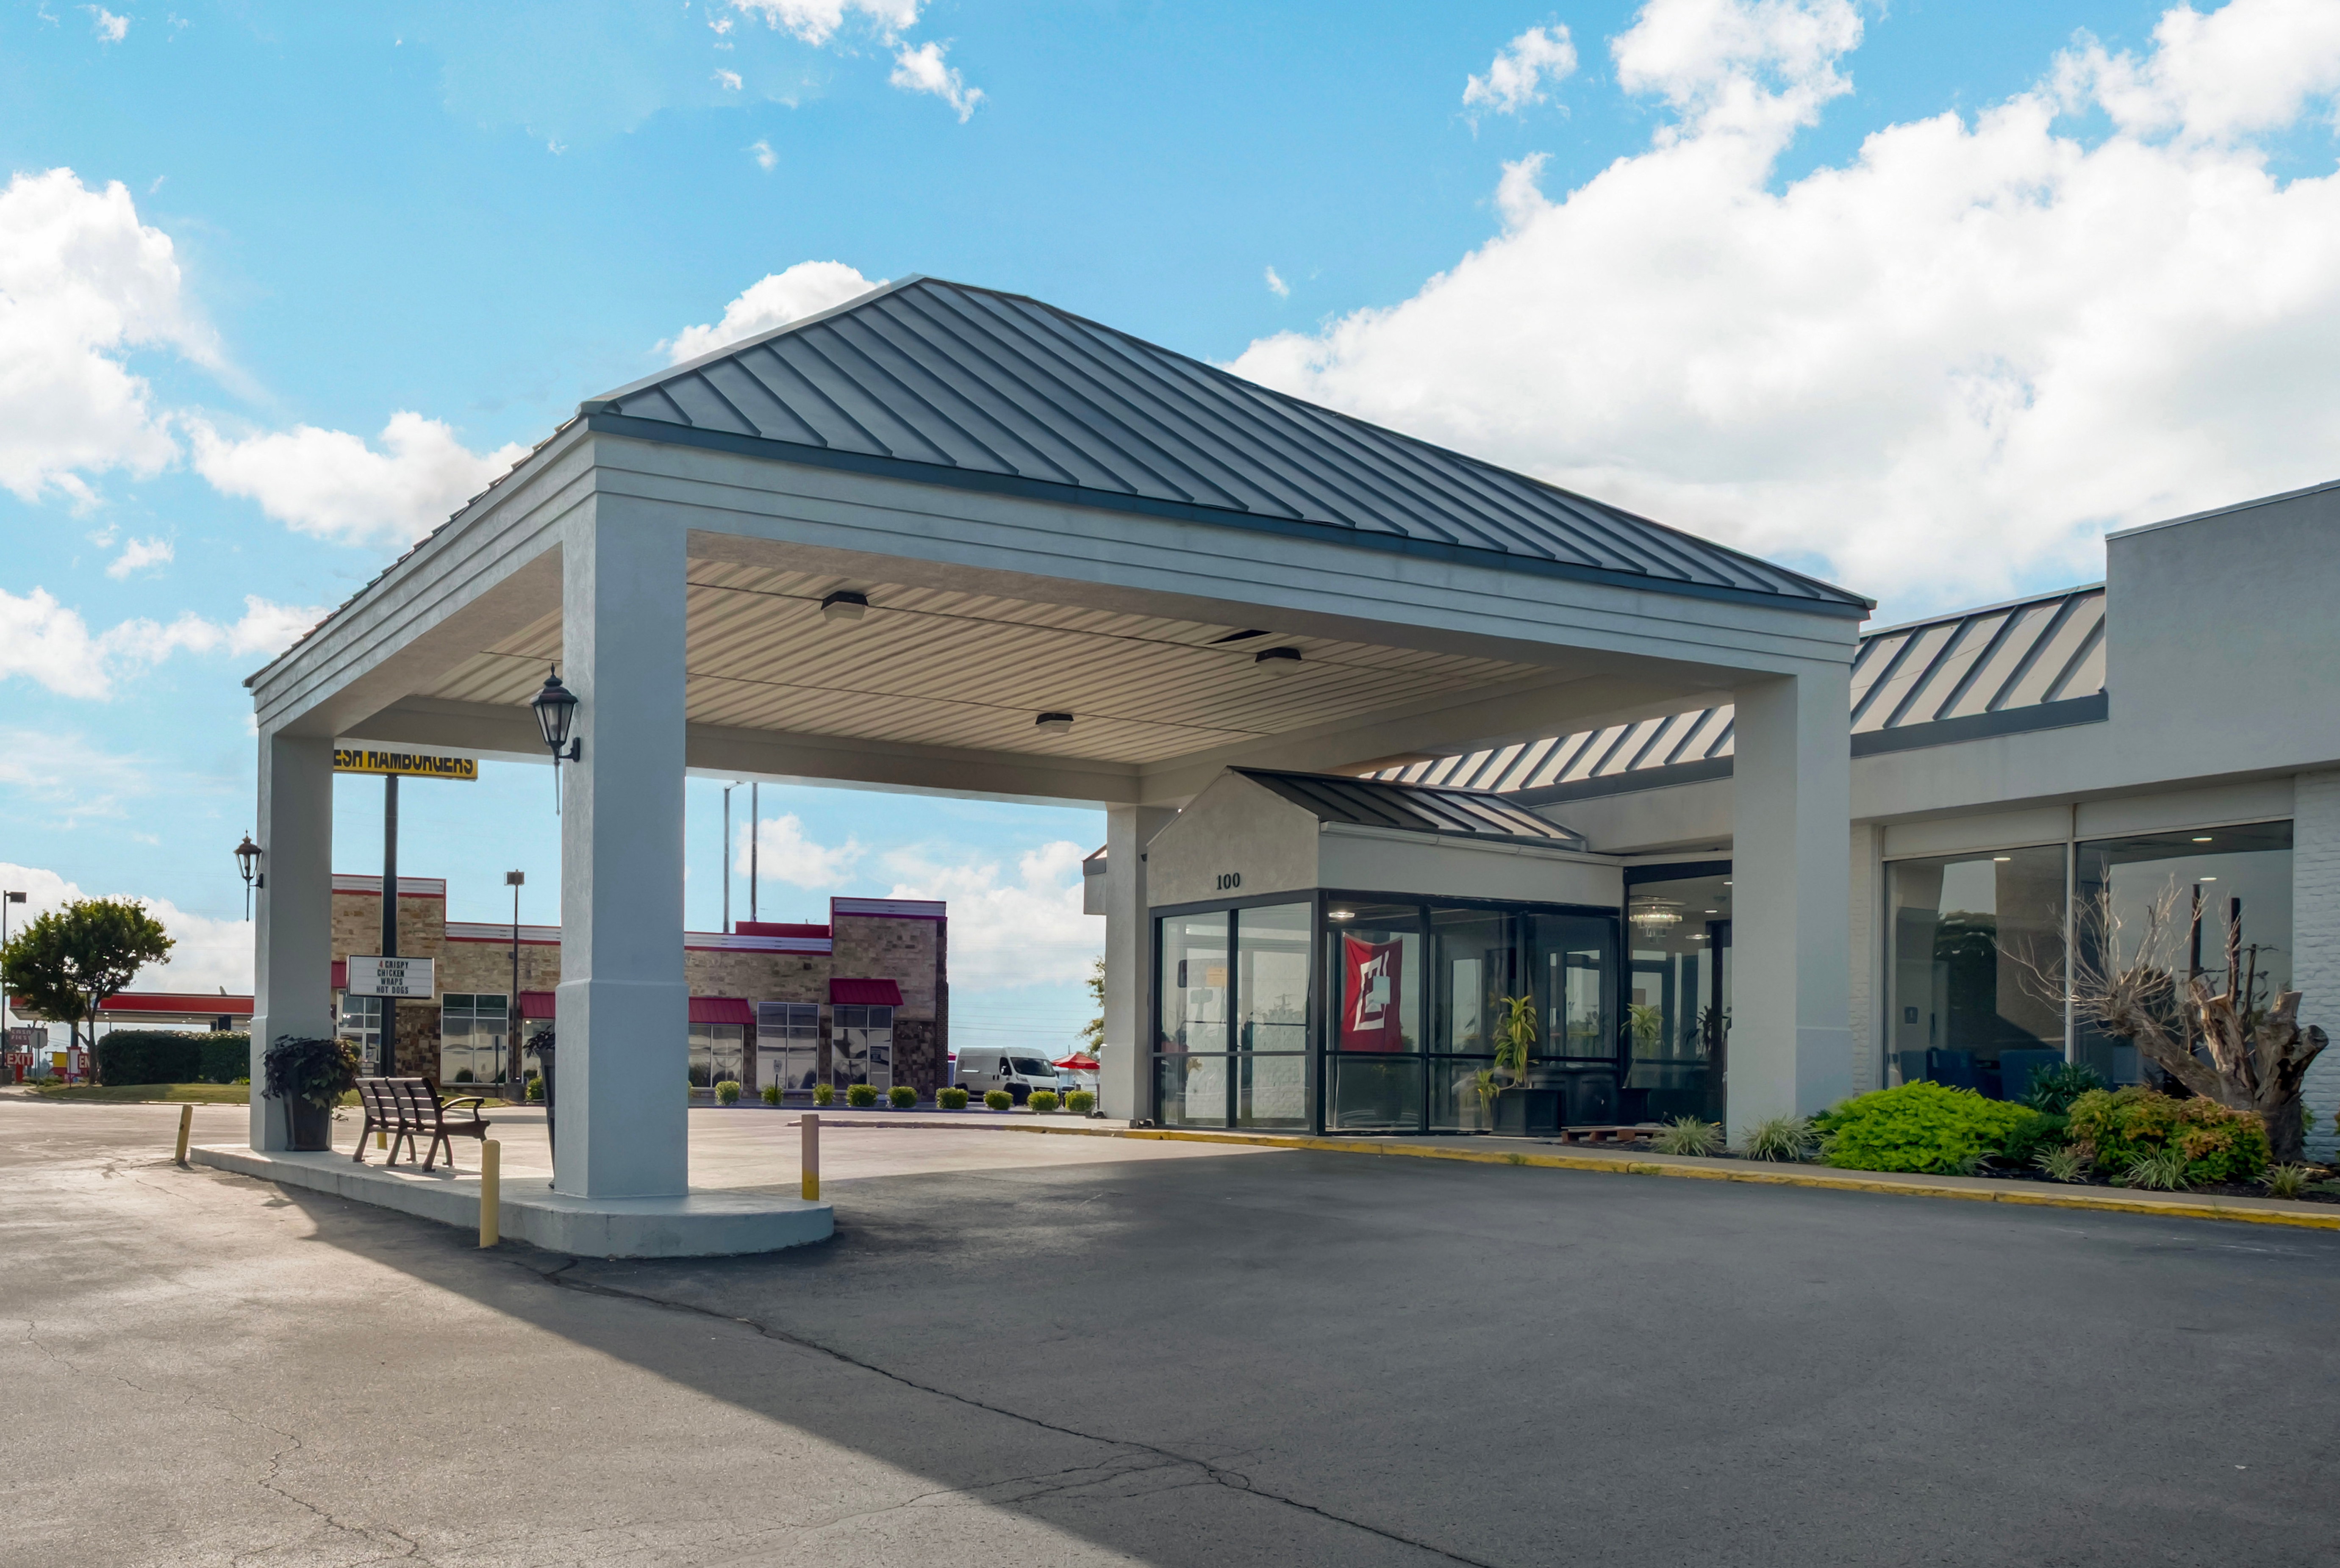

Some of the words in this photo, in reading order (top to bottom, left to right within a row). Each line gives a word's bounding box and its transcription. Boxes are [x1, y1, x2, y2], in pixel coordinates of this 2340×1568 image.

[1216, 873, 1240, 890] 100
[385, 961, 408, 969] CRISPY
[378, 969, 404, 977] CHICKEN
[381, 978, 402, 986] WRAPS
[392, 986, 408, 994] DOGS
[7, 1054, 32, 1065] EXIT
